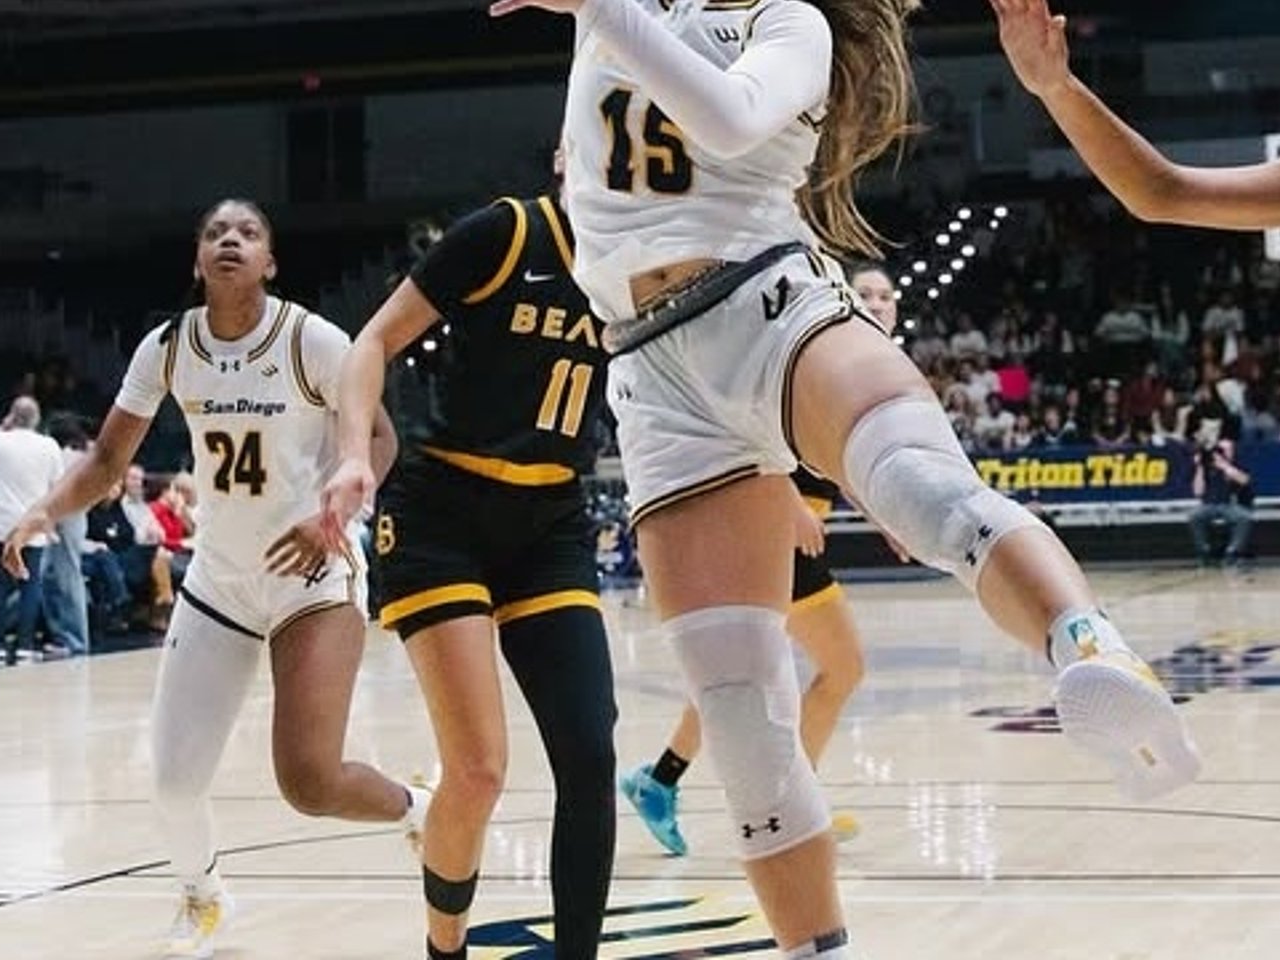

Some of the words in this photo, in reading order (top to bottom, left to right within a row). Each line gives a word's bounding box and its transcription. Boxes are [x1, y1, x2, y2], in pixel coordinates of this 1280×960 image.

[598, 87, 694, 195] 15
[536, 358, 594, 438] 11
[203, 430, 268, 497] 24
[1087, 452, 1169, 487] Tide
